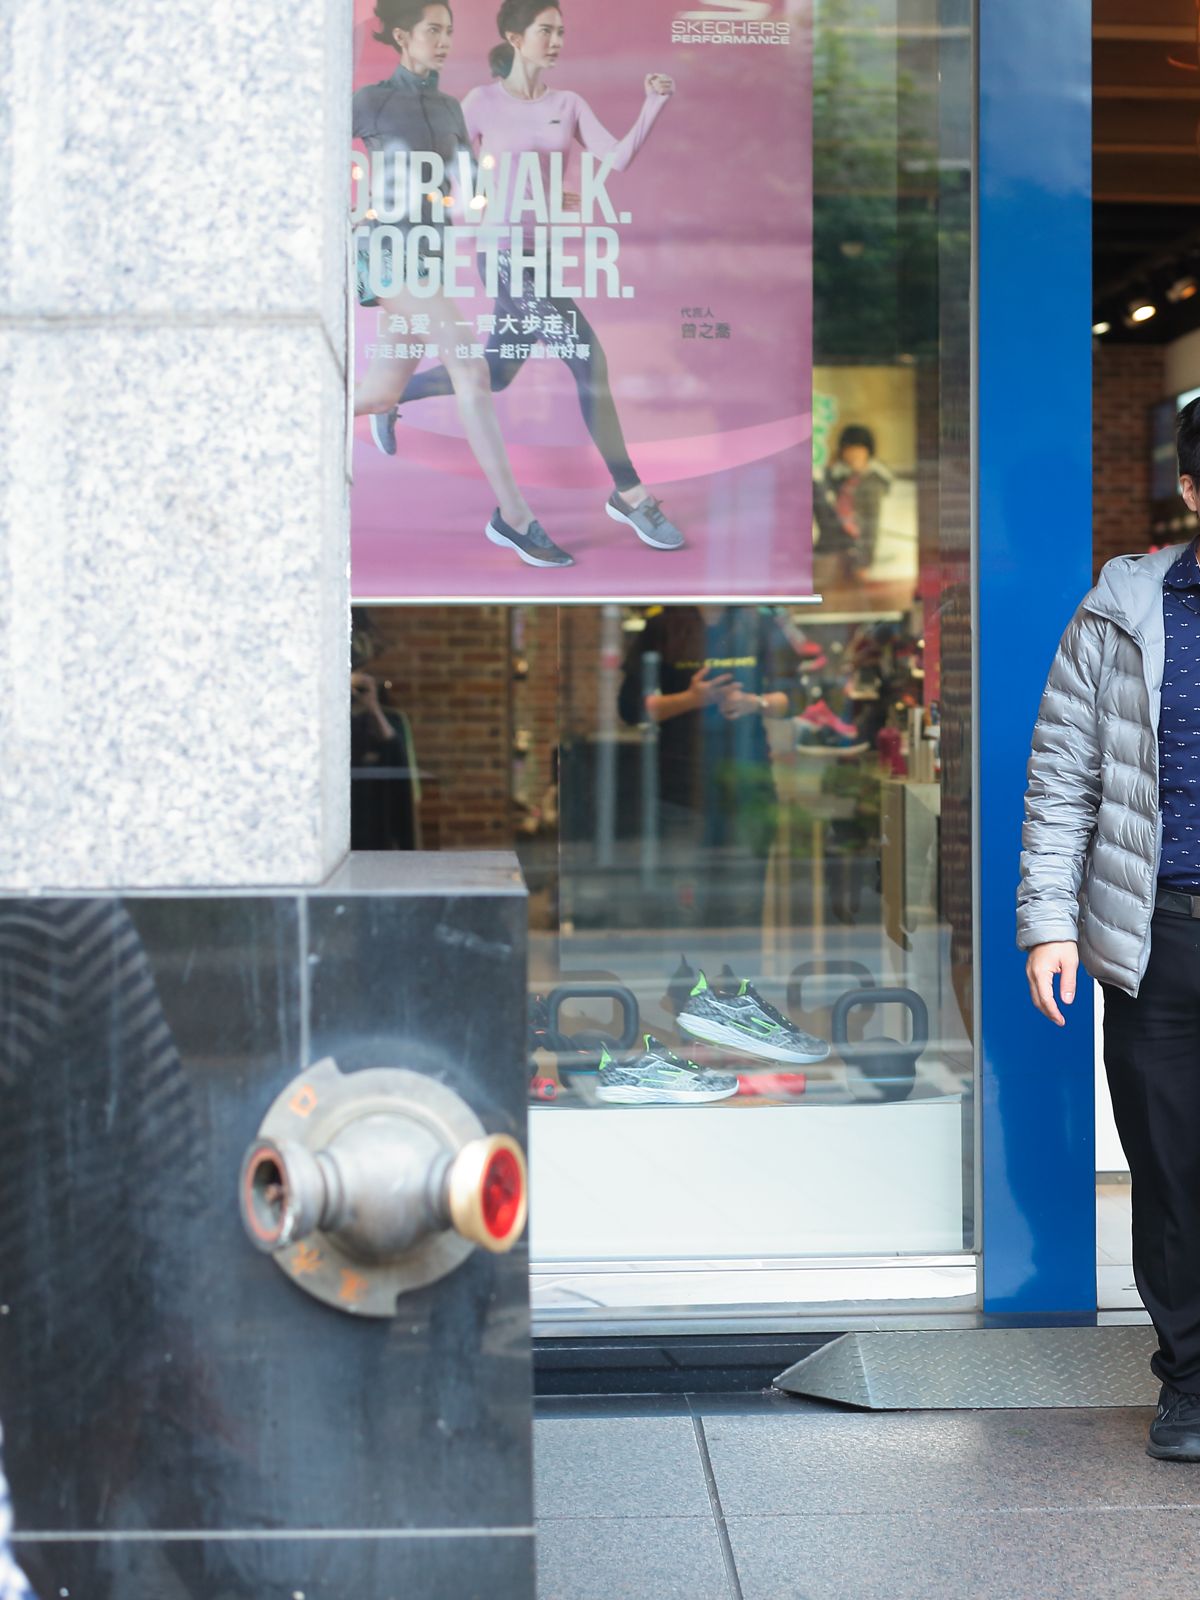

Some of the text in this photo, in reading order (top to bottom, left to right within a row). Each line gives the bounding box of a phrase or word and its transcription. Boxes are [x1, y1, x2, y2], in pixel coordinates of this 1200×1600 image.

[671, 20, 791, 35] SKECHERS
[671, 34, 791, 45] PERFORMANCE
[457, 151, 633, 224] WALK.
[352, 225, 636, 299] TOGETHER.
